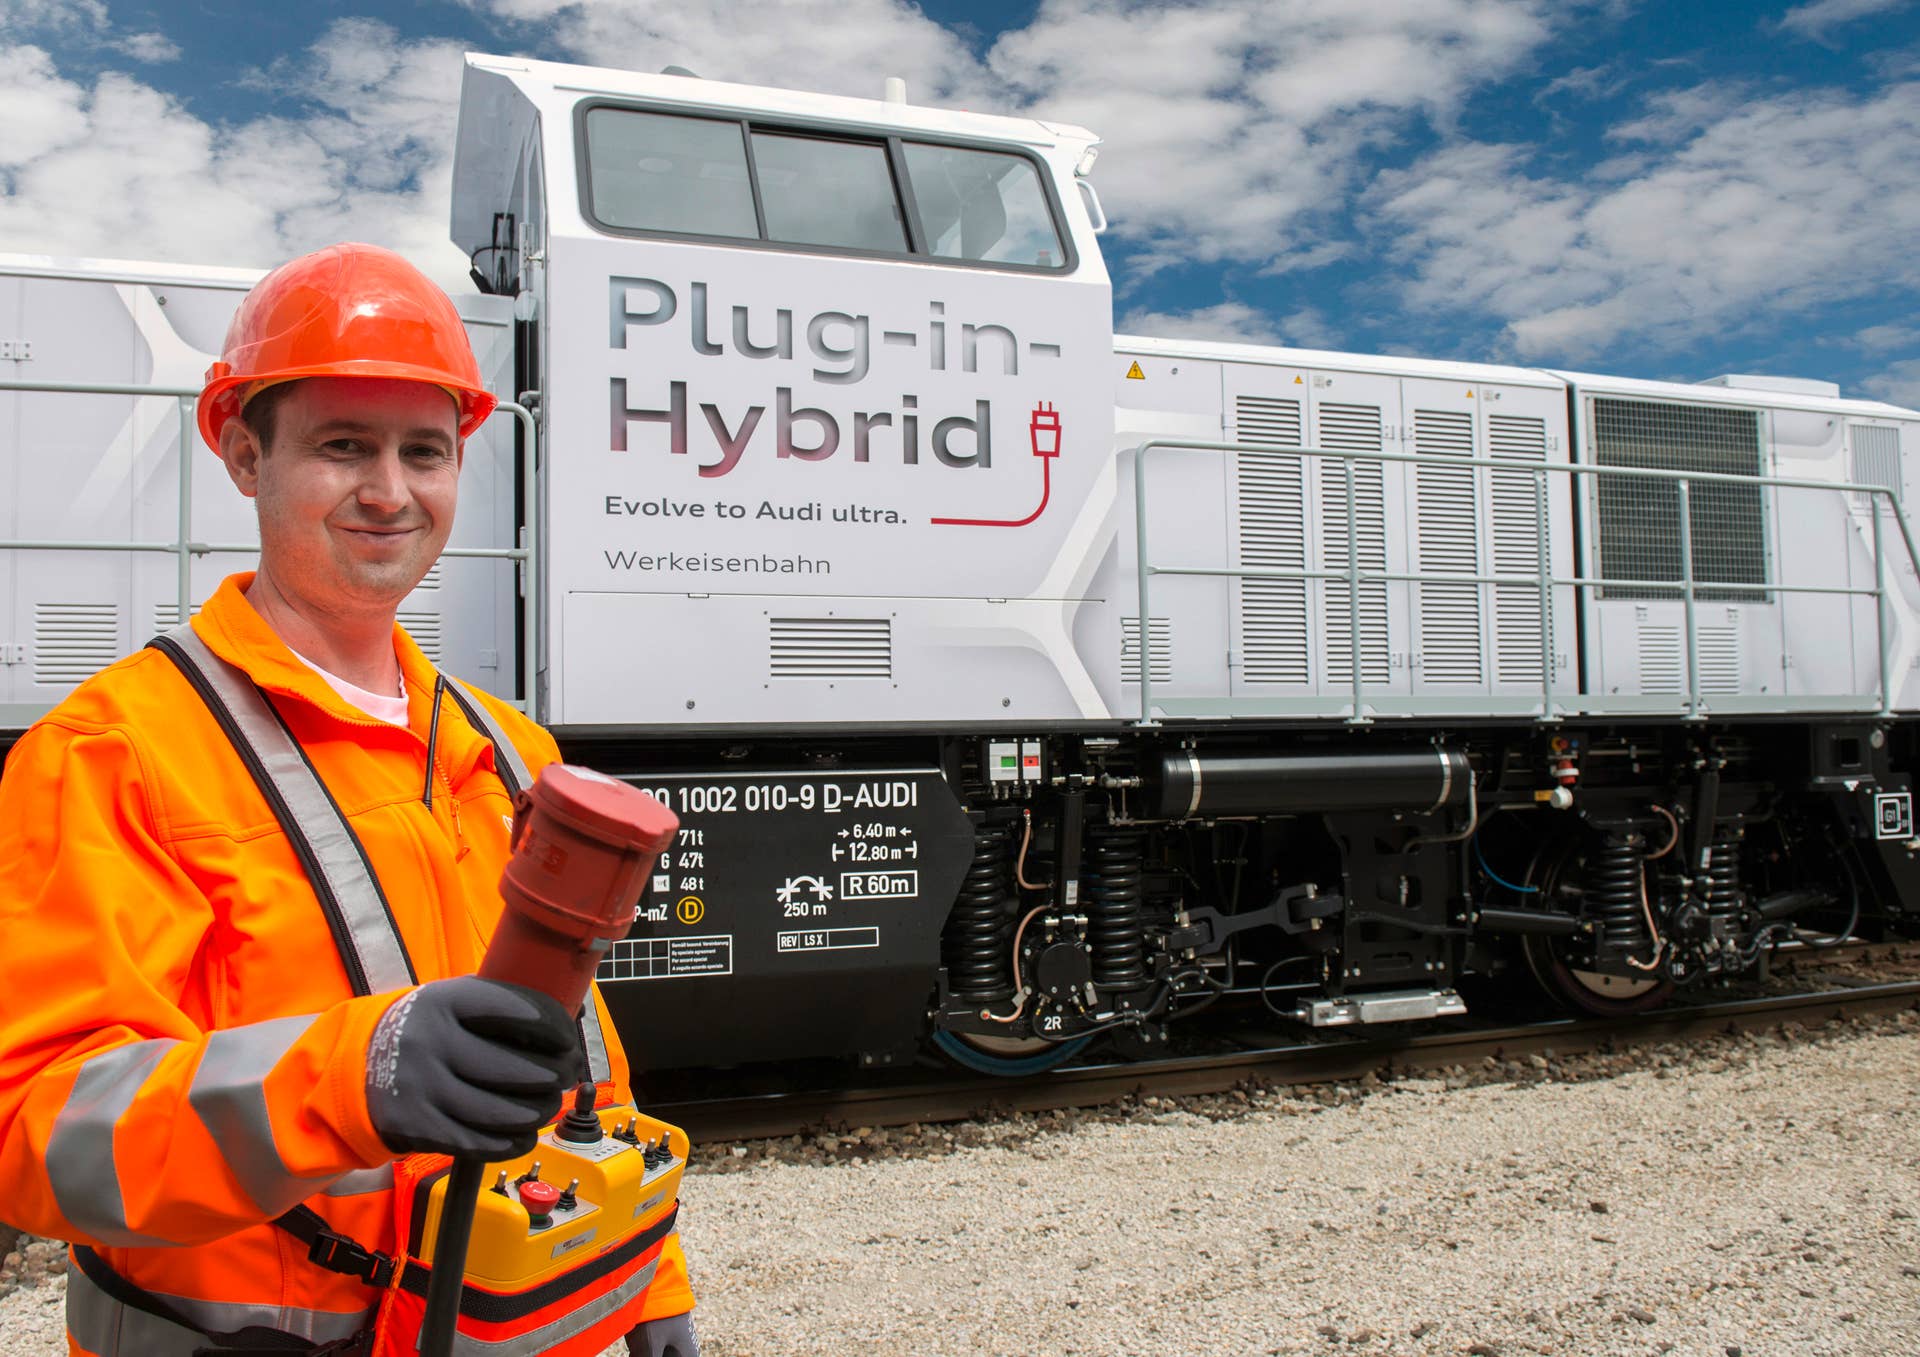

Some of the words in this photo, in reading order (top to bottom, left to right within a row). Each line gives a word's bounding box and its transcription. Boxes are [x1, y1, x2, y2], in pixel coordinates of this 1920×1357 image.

[608, 275, 1061, 385] Plug-in-
[609, 376, 992, 478] Hybrid
[605, 495, 705, 518] Evolve
[714, 500, 746, 519] to
[755, 500, 822, 522] Audi
[832, 503, 908, 525] ultra.
[603, 549, 831, 574] Werkeisenbahn
[678, 785, 737, 813] 1002
[744, 783, 815, 812] 010-9
[823, 781, 918, 813] D-AUDI
[853, 822, 883, 840] 6,40
[885, 825, 897, 838] m
[849, 841, 889, 862] 12,80
[890, 848, 902, 860] m
[849, 876, 864, 895] R
[783, 902, 810, 918] 250
[812, 904, 828, 916] m
[780, 935, 798, 949] REV
[1044, 1015, 1062, 1031] 2R
